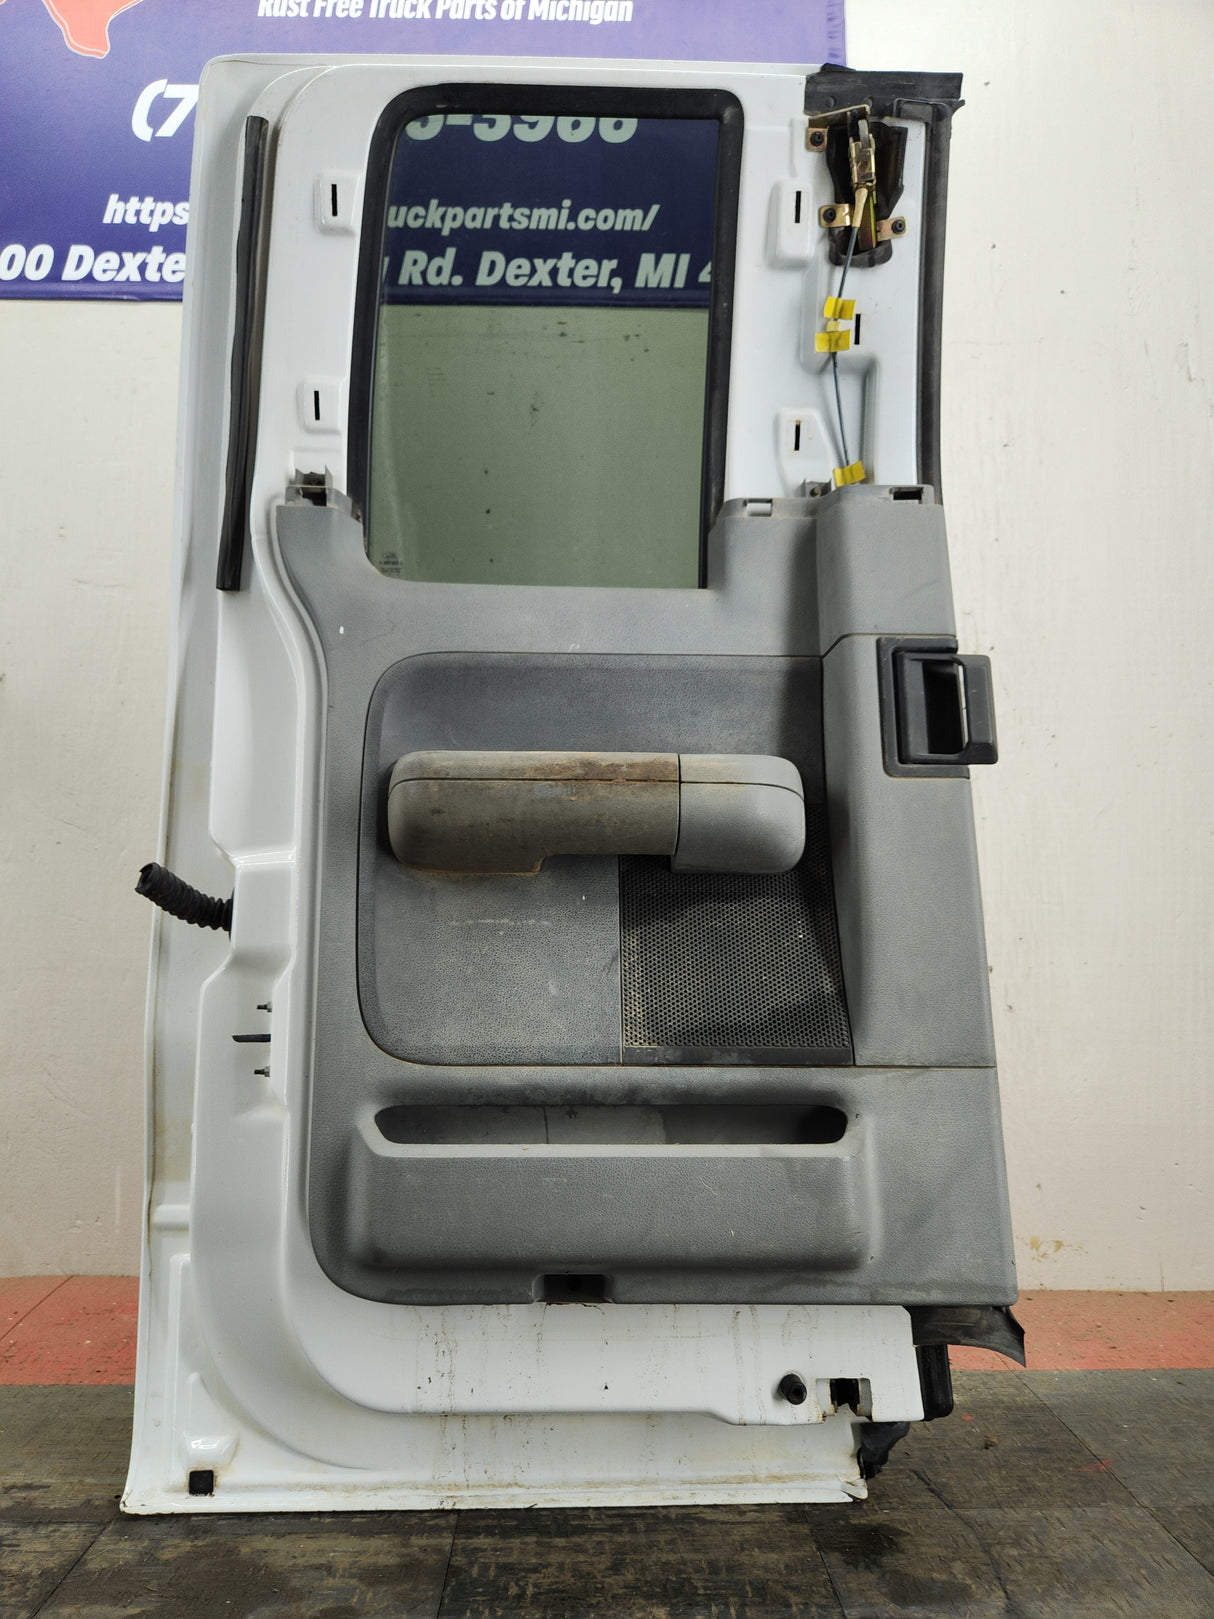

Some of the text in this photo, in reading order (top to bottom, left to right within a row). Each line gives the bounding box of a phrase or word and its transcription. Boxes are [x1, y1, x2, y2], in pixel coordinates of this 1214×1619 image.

[258, 0, 634, 25] Rust Free Truck Parts of Michigan
[102, 193, 190, 232] https
[398, 247, 464, 286] Rd.
[475, 250, 623, 294] Dexter,
[634, 253, 691, 288] MI
